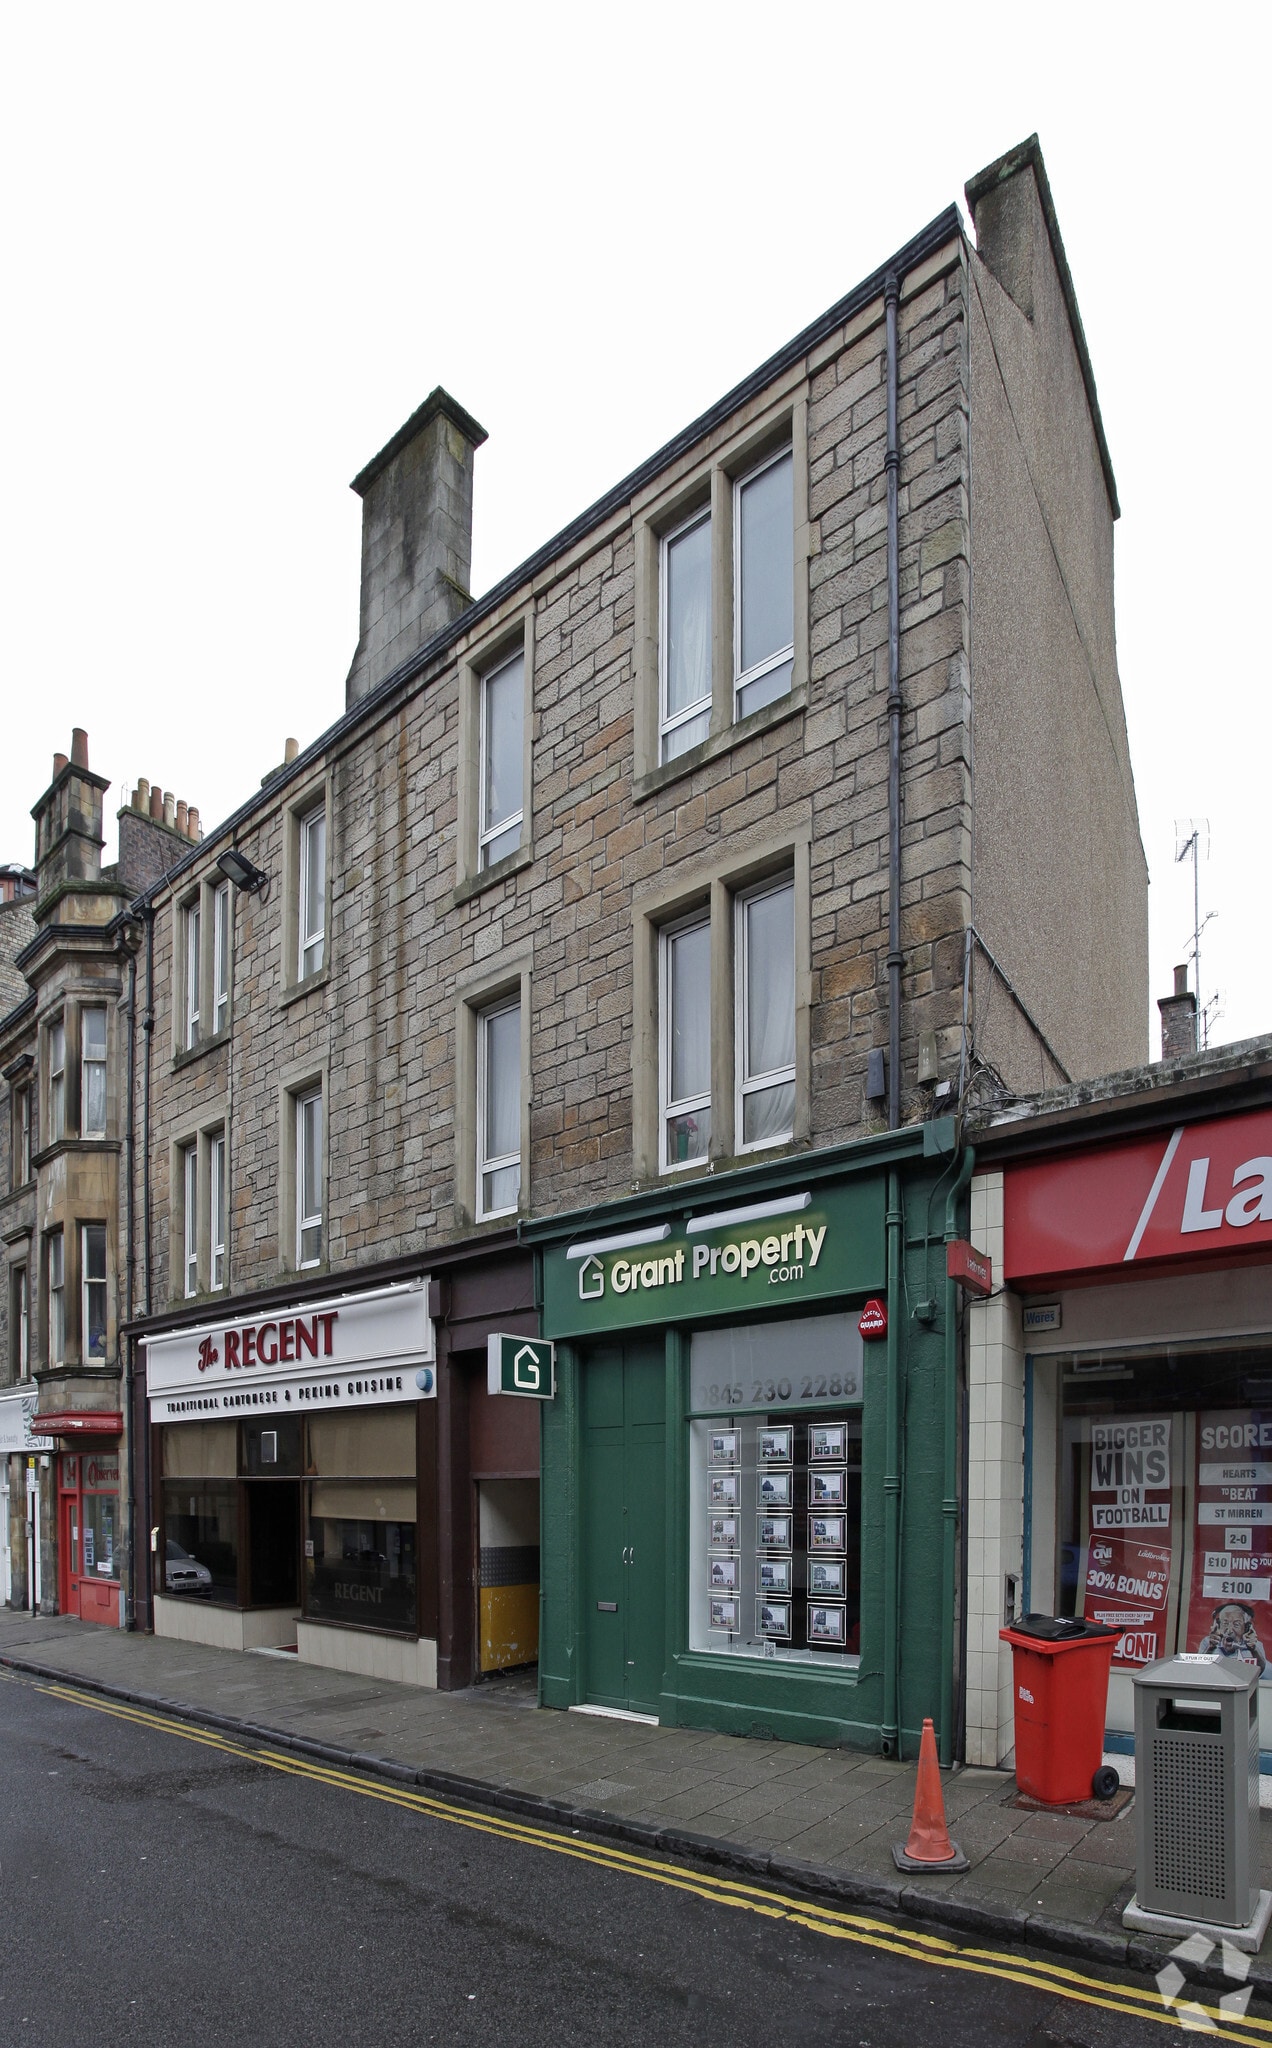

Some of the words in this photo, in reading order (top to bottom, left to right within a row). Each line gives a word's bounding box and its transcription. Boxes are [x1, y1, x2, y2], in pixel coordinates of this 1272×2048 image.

[611, 1249, 685, 1293] Grant
[692, 1223, 827, 1279] Property
[767, 1263, 804, 1286] .com
[862, 1309, 881, 1320] ELECTRO
[859, 1319, 884, 1330] GUARD
[197, 1334, 219, 1372] The
[224, 1310, 339, 1370] REGENT
[166, 1397, 219, 1413] TRADITIONAL
[223, 1390, 278, 1408] CANTONESE
[284, 1389, 292, 1401] &
[298, 1383, 340, 1400] PEKING
[347, 1376, 403, 1395] CUISINE
[751, 1376, 793, 1403] 230
[799, 1370, 858, 1399] 2288
[1094, 1423, 1167, 1451] BIGGER
[1095, 1449, 1166, 1487] WINS
[1222, 1469, 1257, 1479] HEARTS
[1121, 1487, 1140, 1505] ON
[1221, 1487, 1230, 1496] TO
[1230, 1487, 1258, 1501] BEAT
[1096, 1506, 1168, 1525] FOOTBALL
[1214, 1508, 1226, 1519] ST
[1227, 1508, 1263, 1519] MIRREN
[1229, 1533, 1247, 1545] 2-0
[1207, 1556, 1228, 1568] £10
[1231, 1557, 1259, 1571] WINS
[1086, 1569, 1116, 1590] 30%
[1117, 1575, 1164, 1600] BONUS
[1147, 1570, 1157, 1580] UP
[1158, 1571, 1167, 1582] TO
[334, 1582, 384, 1604] REGENT
[1221, 1581, 1253, 1595] £100
[1124, 1633, 1154, 1660] ON!
